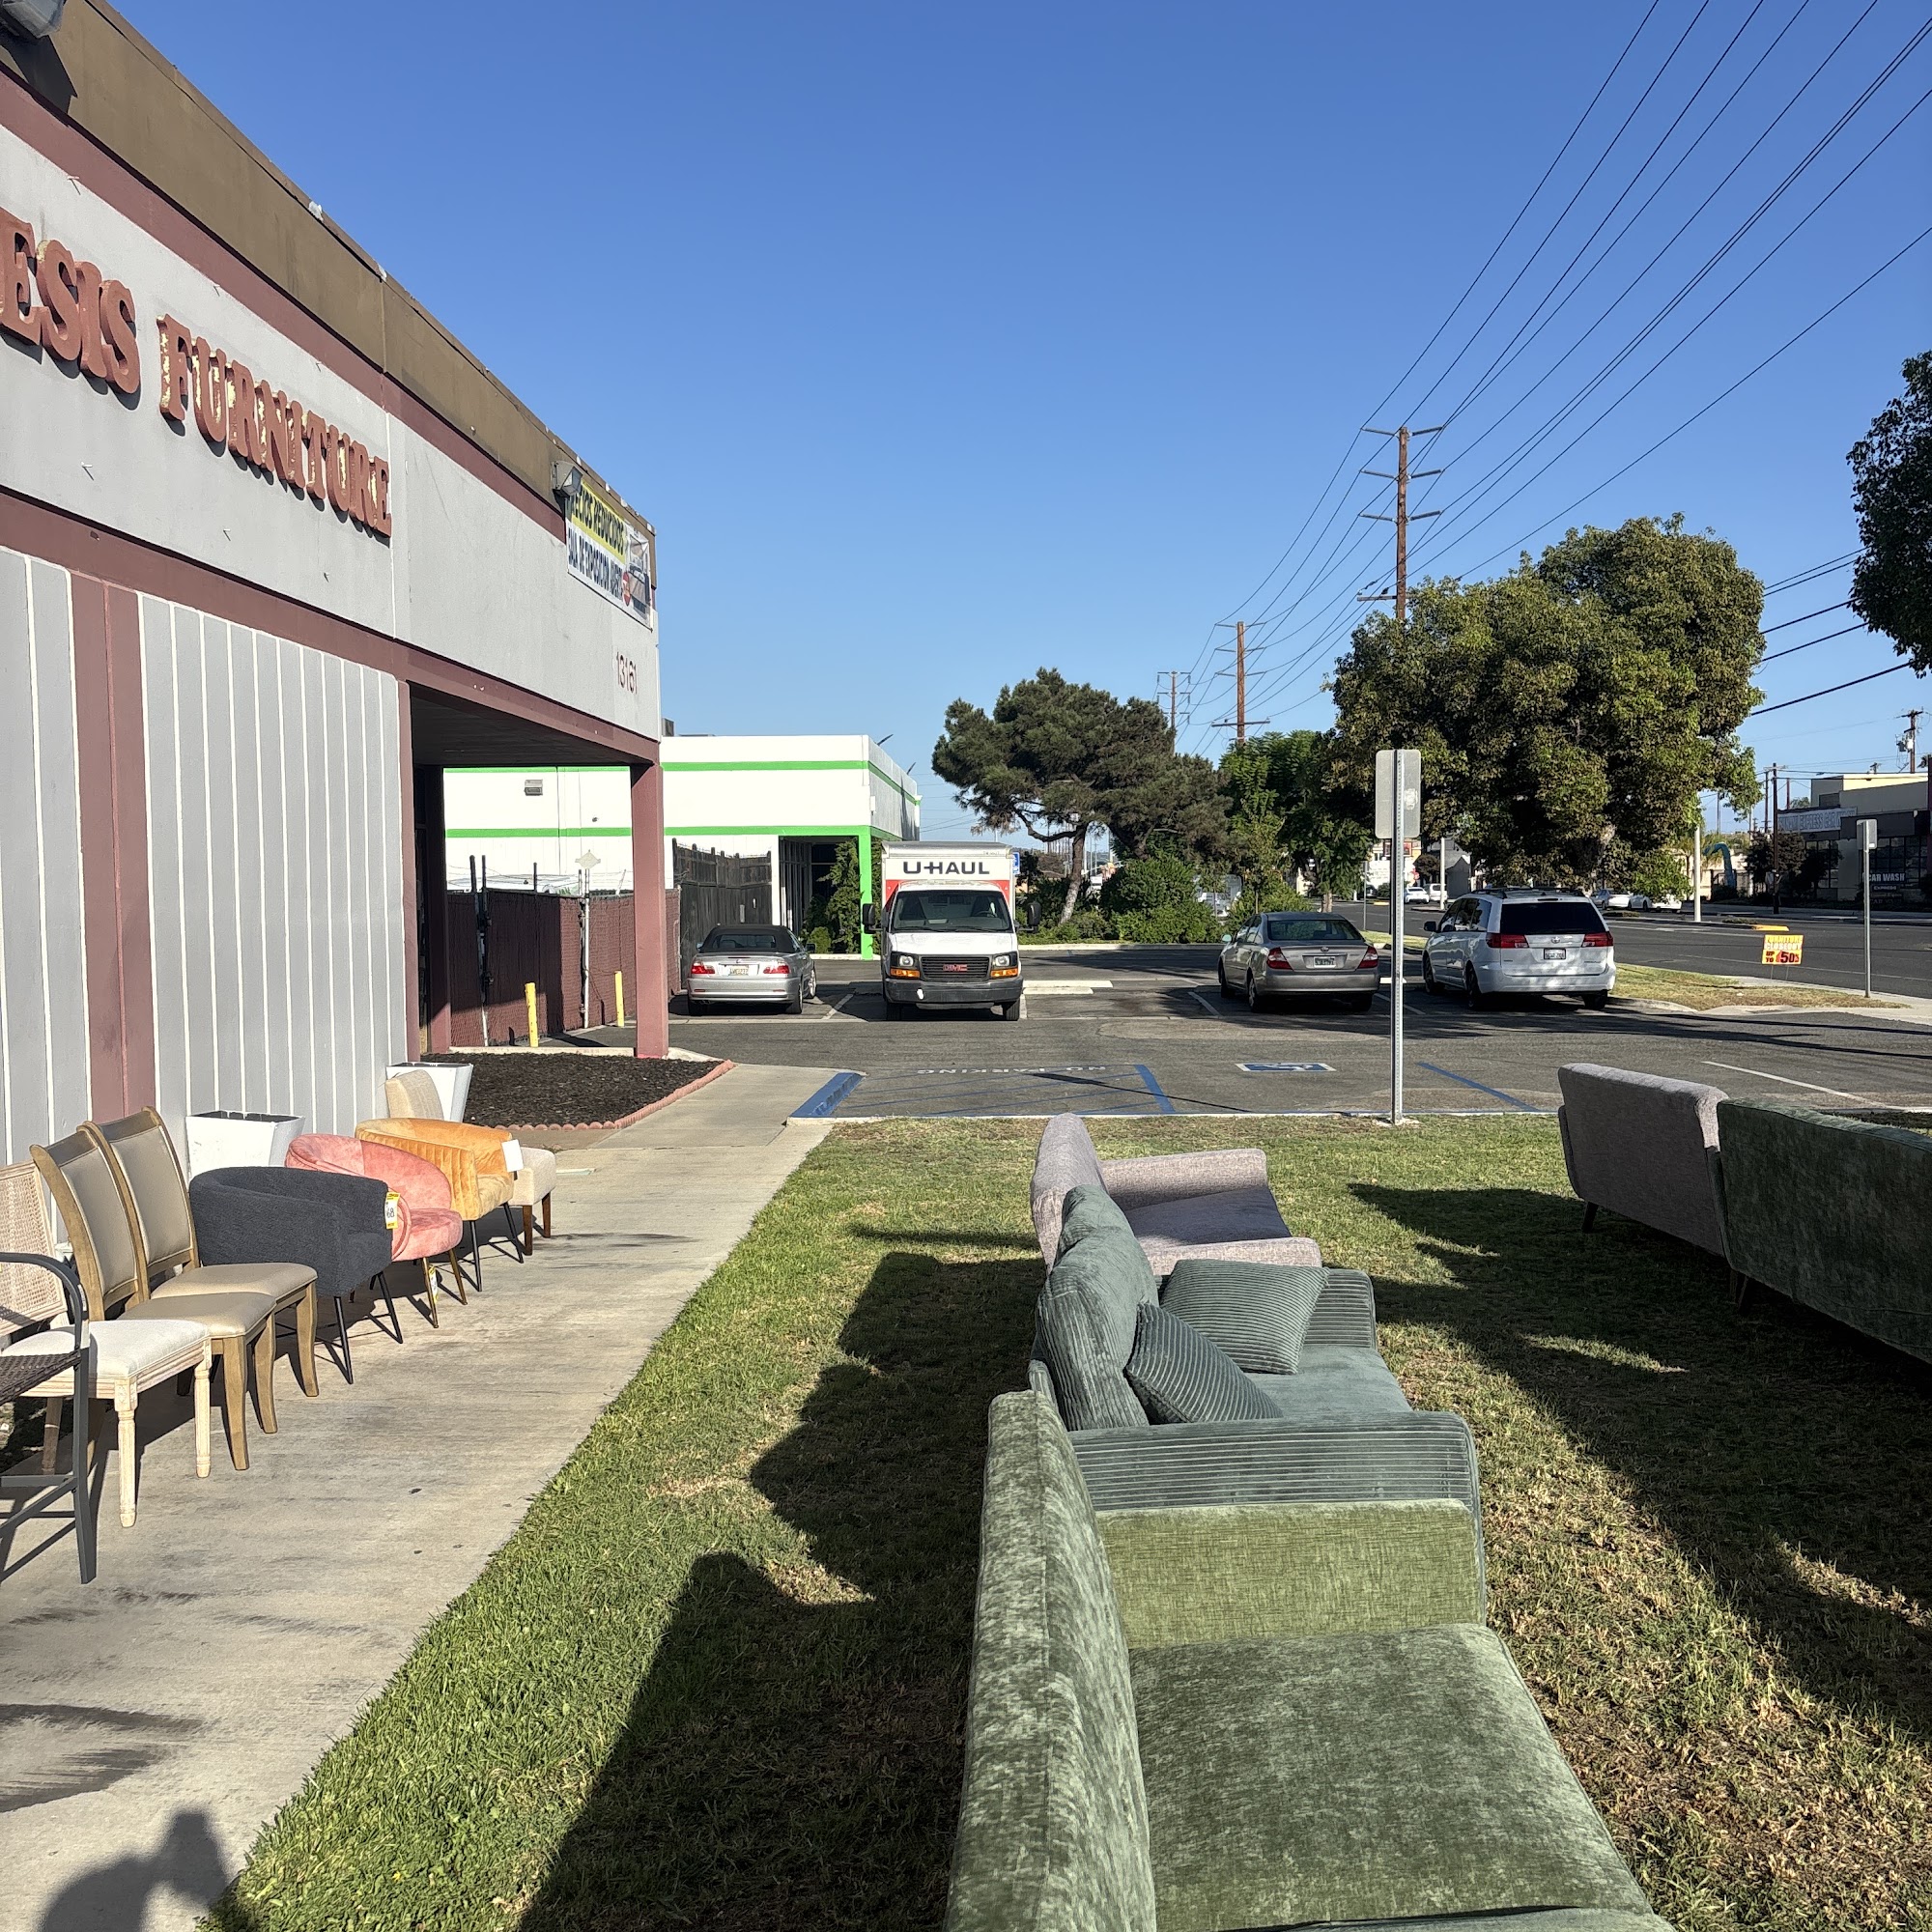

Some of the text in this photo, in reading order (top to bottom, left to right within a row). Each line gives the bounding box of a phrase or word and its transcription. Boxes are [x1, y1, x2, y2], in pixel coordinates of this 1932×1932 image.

[0, 206, 392, 539] ESIS FURNITURE
[616, 651, 638, 695] 13161
[902, 861, 990, 875] U-HAUL
[1882, 872, 1905, 882] WASH
[917, 1066, 1046, 1075] PARKING
